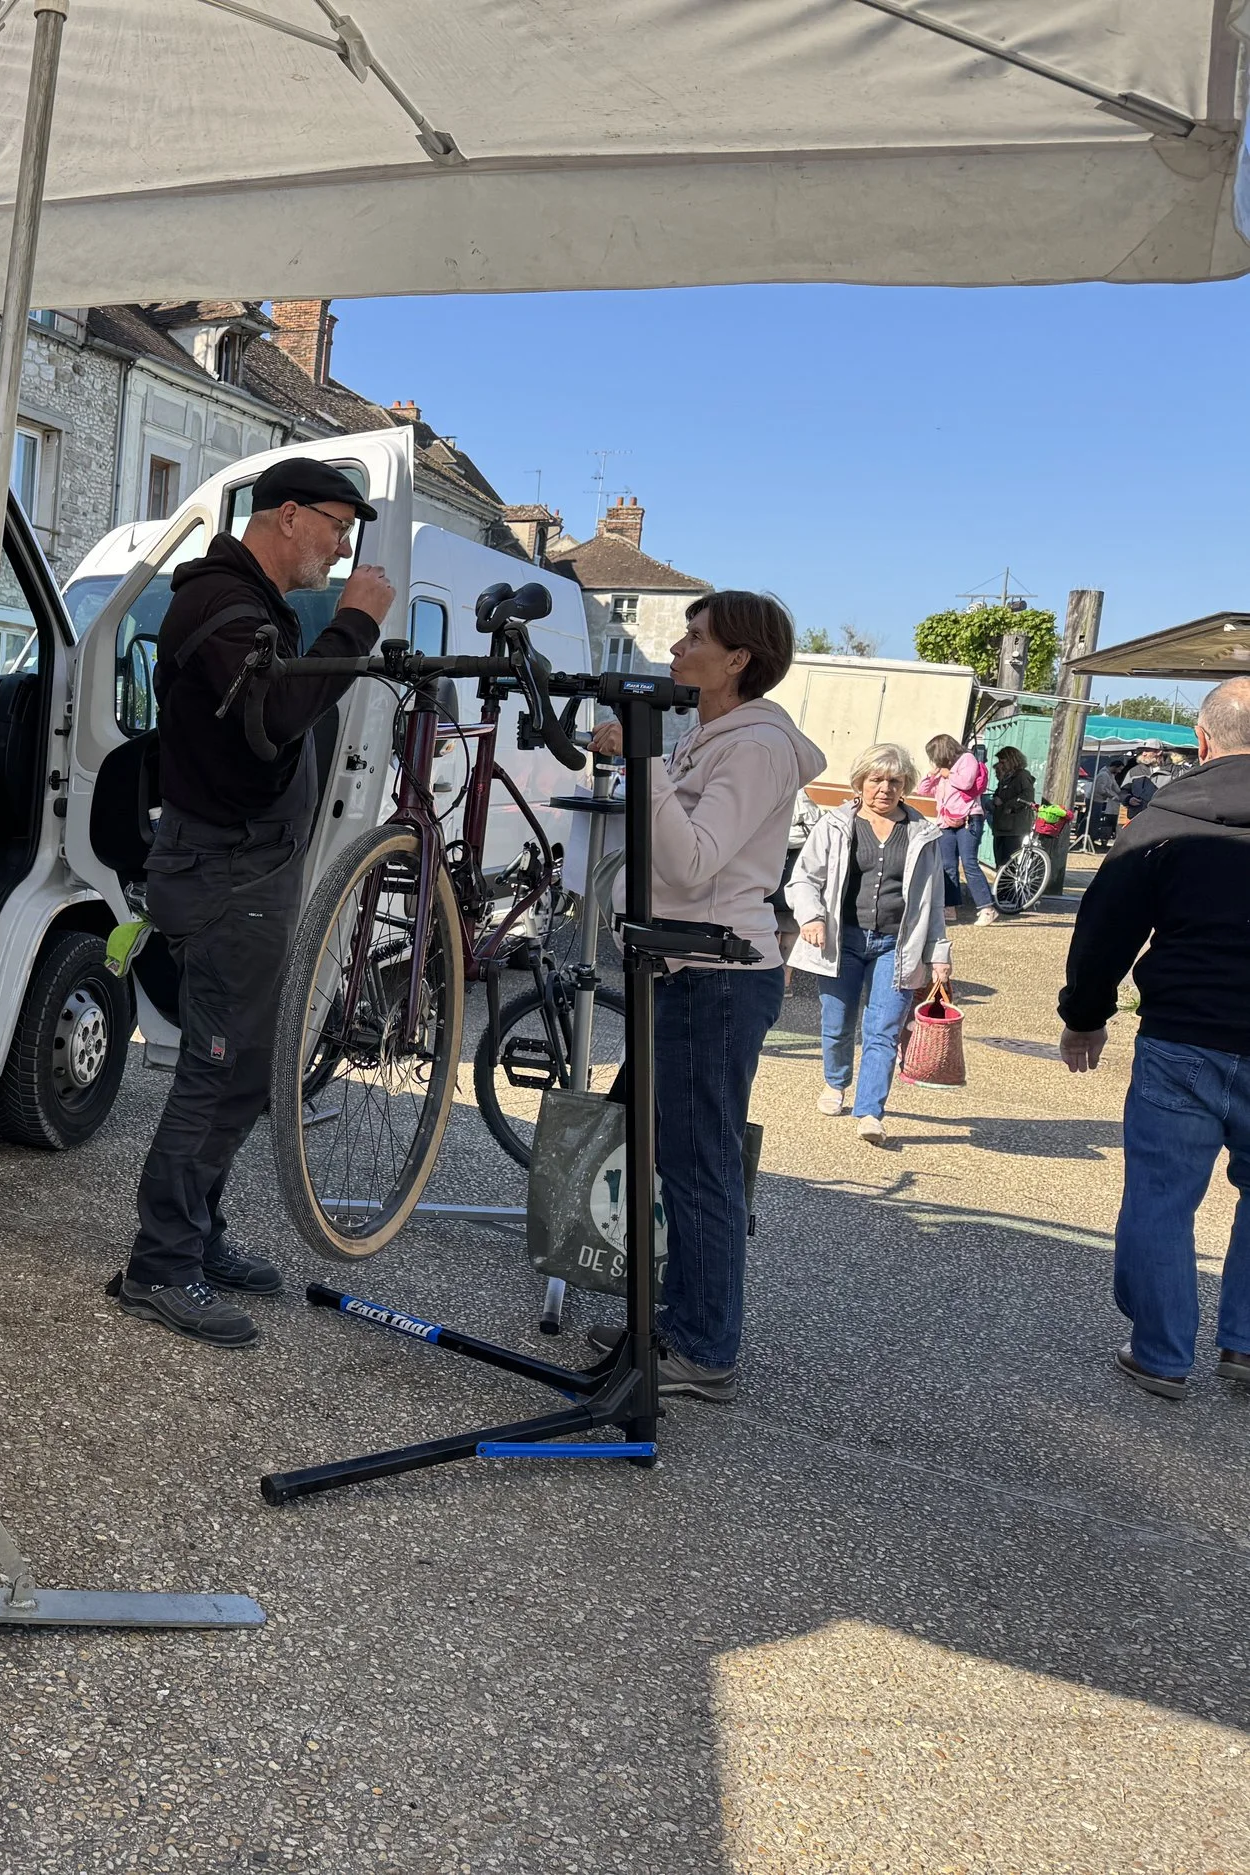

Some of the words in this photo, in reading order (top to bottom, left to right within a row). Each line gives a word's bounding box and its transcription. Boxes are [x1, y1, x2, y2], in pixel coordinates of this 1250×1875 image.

[578, 1244, 608, 1273] DE
[346, 1299, 391, 1324] Park
[390, 1313, 436, 1338] Tool
